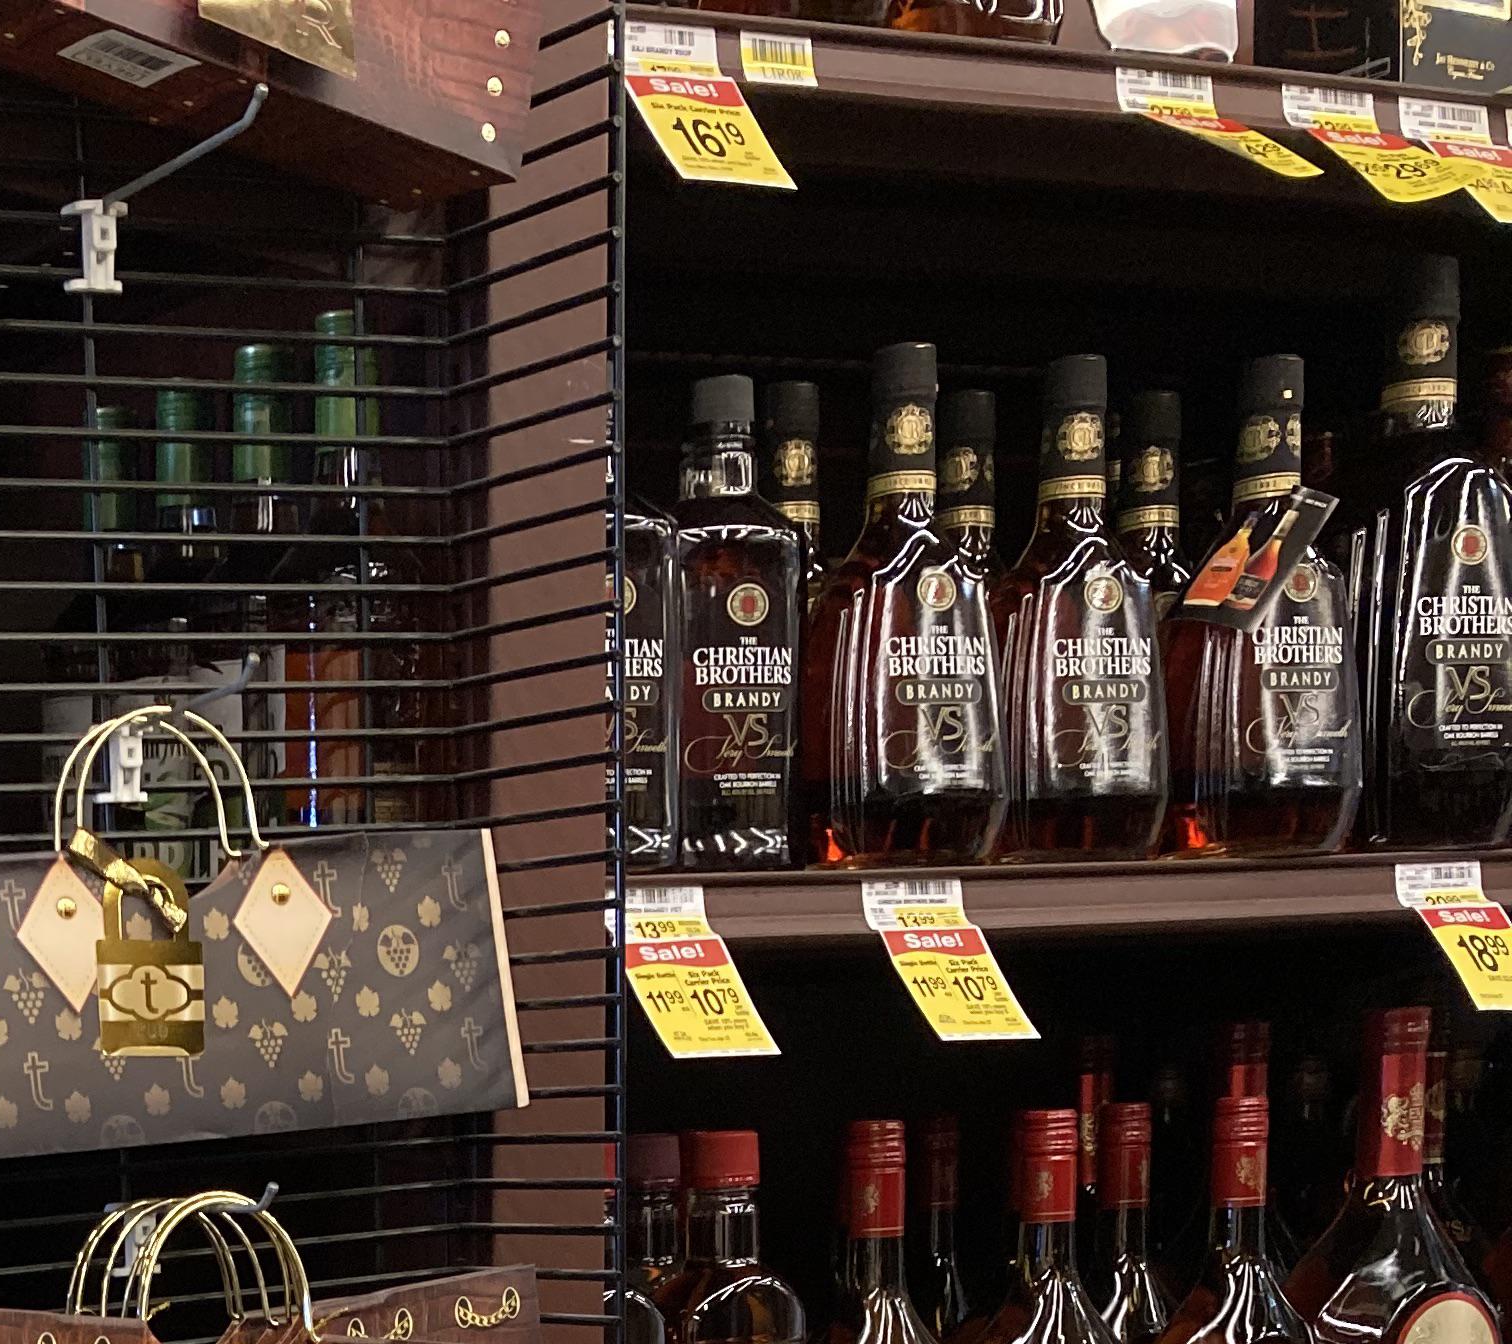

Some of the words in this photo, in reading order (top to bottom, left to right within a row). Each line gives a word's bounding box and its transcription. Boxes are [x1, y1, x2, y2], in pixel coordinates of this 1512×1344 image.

[649, 78, 718, 97] Sale!
[1327, 132, 1387, 147] Sale!
[1447, 146, 1500, 162] Sale!
[1463, 585, 1481, 594] THE
[740, 637, 758, 646] THE
[1253, 627, 1344, 646] CHRISTIAN
[693, 647, 792, 667] CHRISTIAN
[887, 637, 986, 657] CHRISTIAN
[1254, 645, 1344, 665] BROTHERS
[1436, 643, 1504, 659] BRANDY
[695, 666, 792, 686] BROTHERS
[888, 656, 986, 676] BROTHERS
[1268, 672, 1331, 687] BRANDY
[1444, 665, 1491, 700] VS
[713, 692, 781, 708] BRANDY
[906, 683, 974, 699] BRANDY
[724, 713, 769, 747] VS
[1438, 909, 1491, 924] Sale!
[634, 919, 676, 940] 1399
[638, 942, 705, 963] Sale!
[1457, 934, 1509, 972] 1899
[646, 989, 684, 1014] 1199
[690, 987, 740, 1017] 1079
